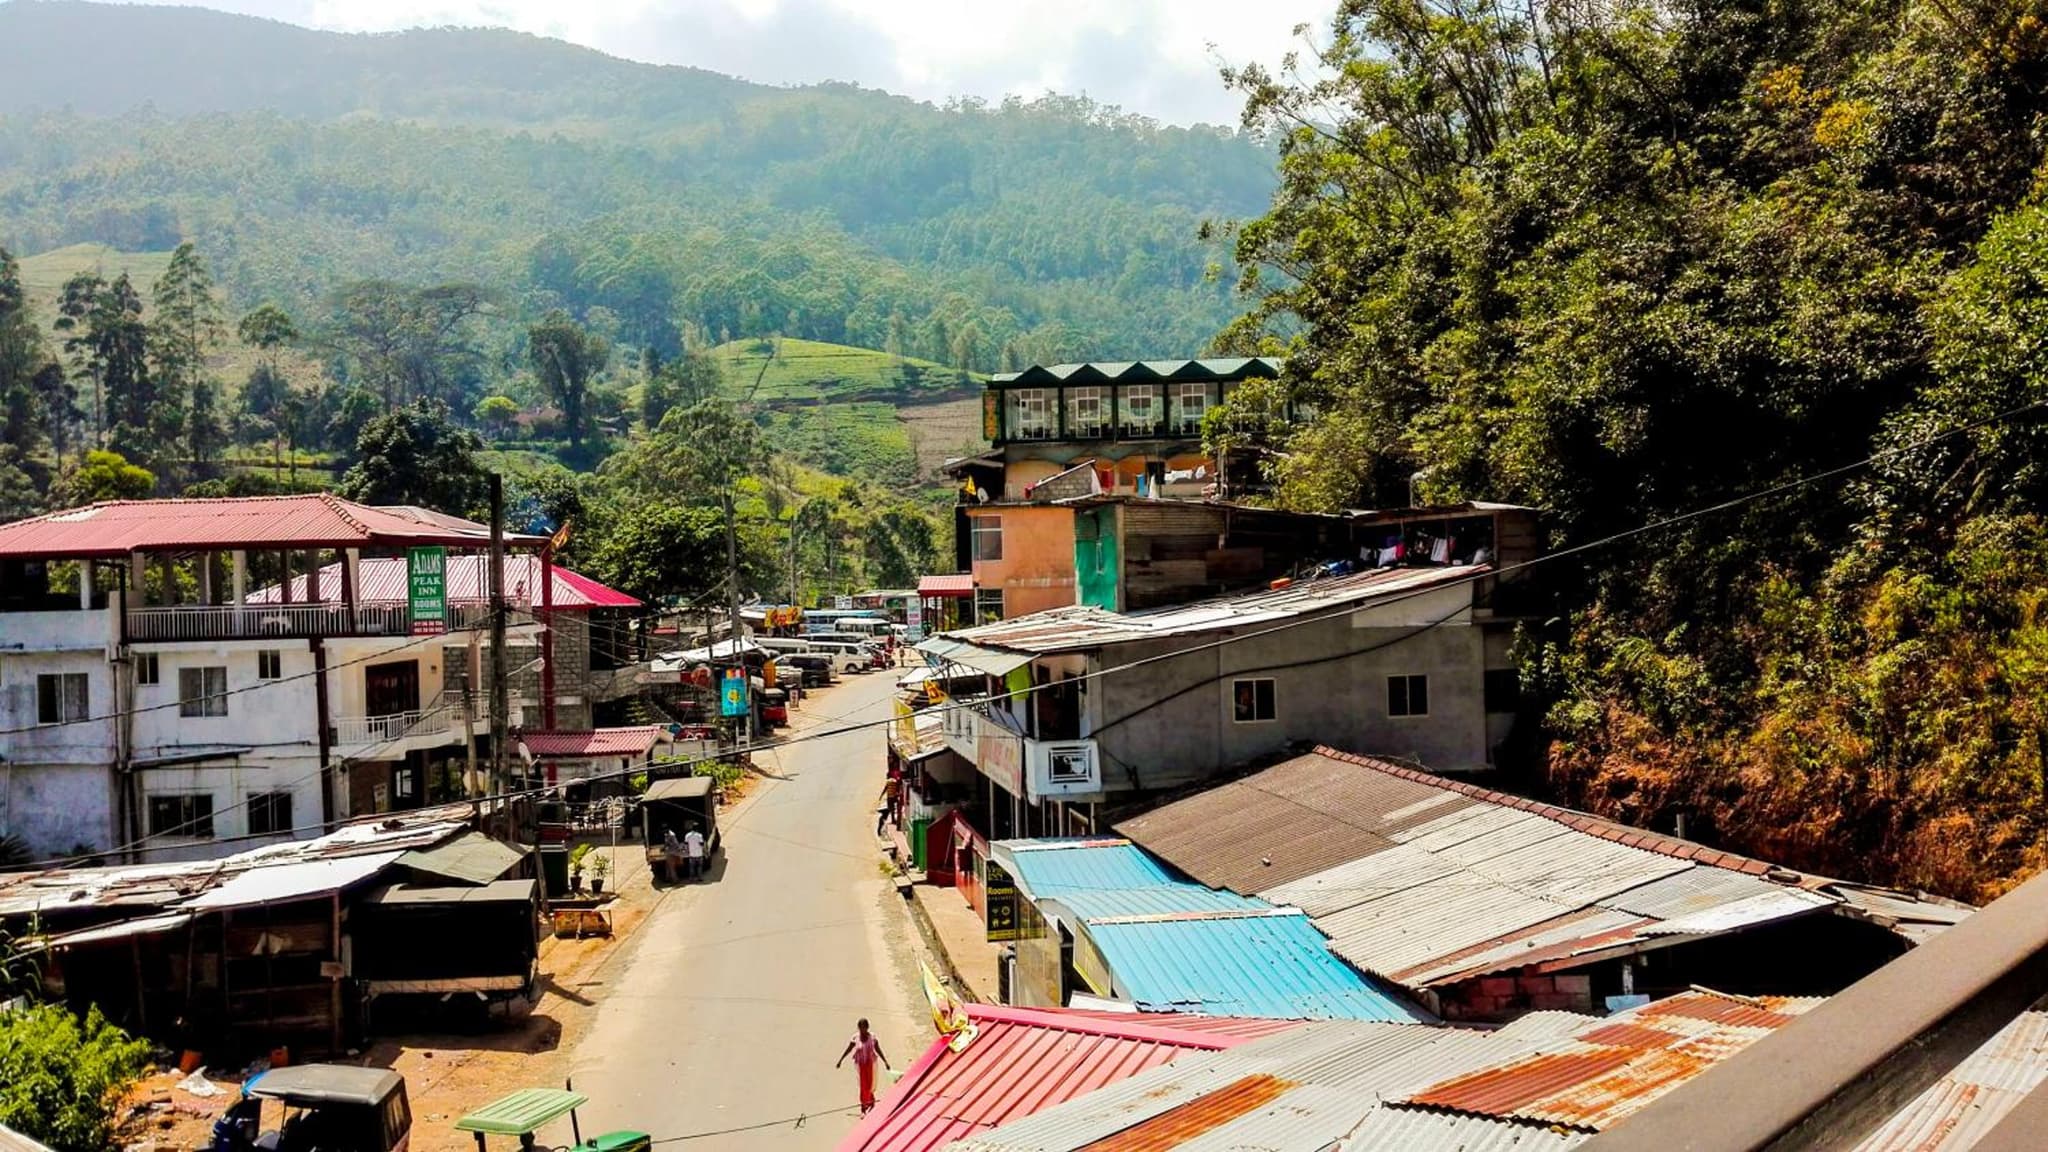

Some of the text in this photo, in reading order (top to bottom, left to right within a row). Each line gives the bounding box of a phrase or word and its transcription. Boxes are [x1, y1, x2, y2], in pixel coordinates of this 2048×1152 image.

[413, 551, 442, 574] ADAMS
[413, 577, 442, 585] PEAK
[418, 587, 437, 596] INN
[414, 600, 442, 608] ROOMS
[988, 887, 1013, 895] Rooms
